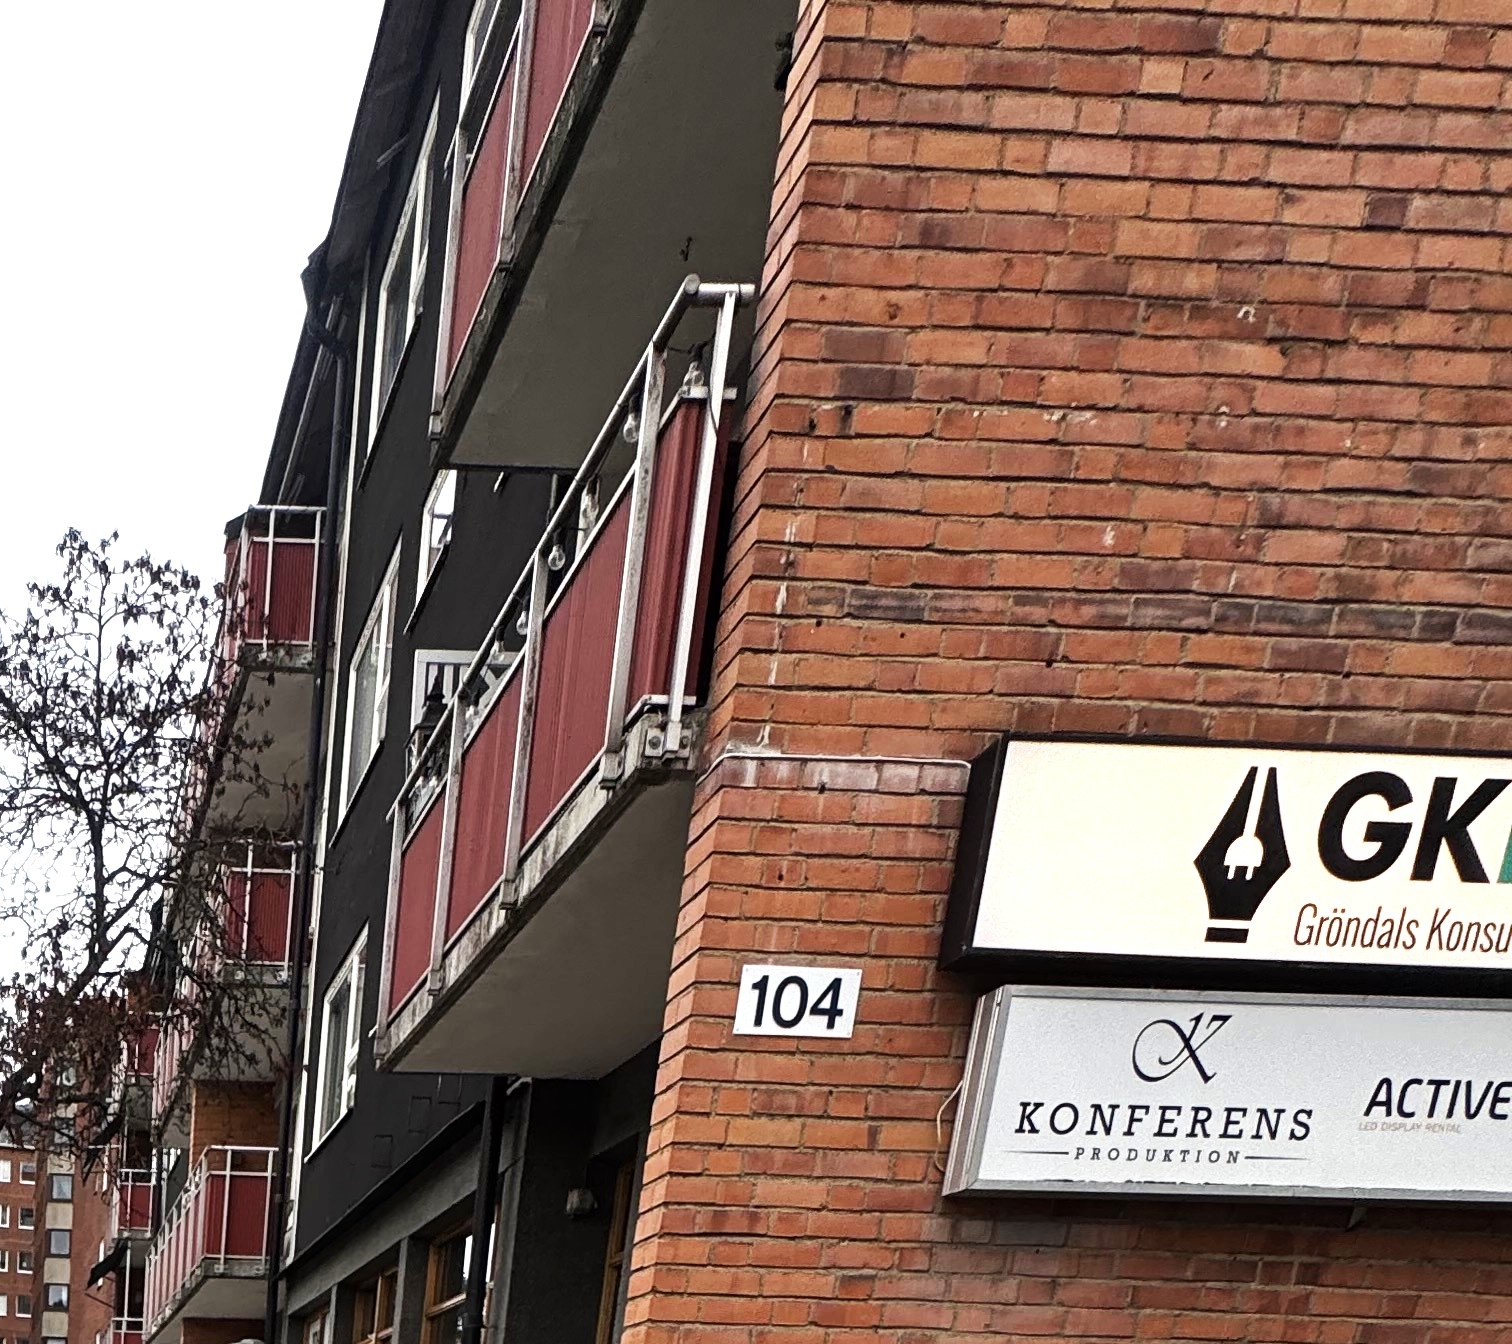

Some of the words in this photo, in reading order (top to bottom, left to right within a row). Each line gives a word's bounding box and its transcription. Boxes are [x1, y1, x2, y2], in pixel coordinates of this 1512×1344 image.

[1317, 770, 1512, 884] GK
[1293, 902, 1419, 949] Gröndals
[751, 974, 844, 1030] 104
[1363, 1077, 1512, 1120] ACTIVE
[1014, 1101, 1314, 1141] KONFERENS
[1358, 1121, 1378, 1132] LED
[1380, 1122, 1423, 1133] DISPLAY
[1425, 1123, 1463, 1135] RENTAL
[1073, 1147, 1241, 1164] PRODUKTION
